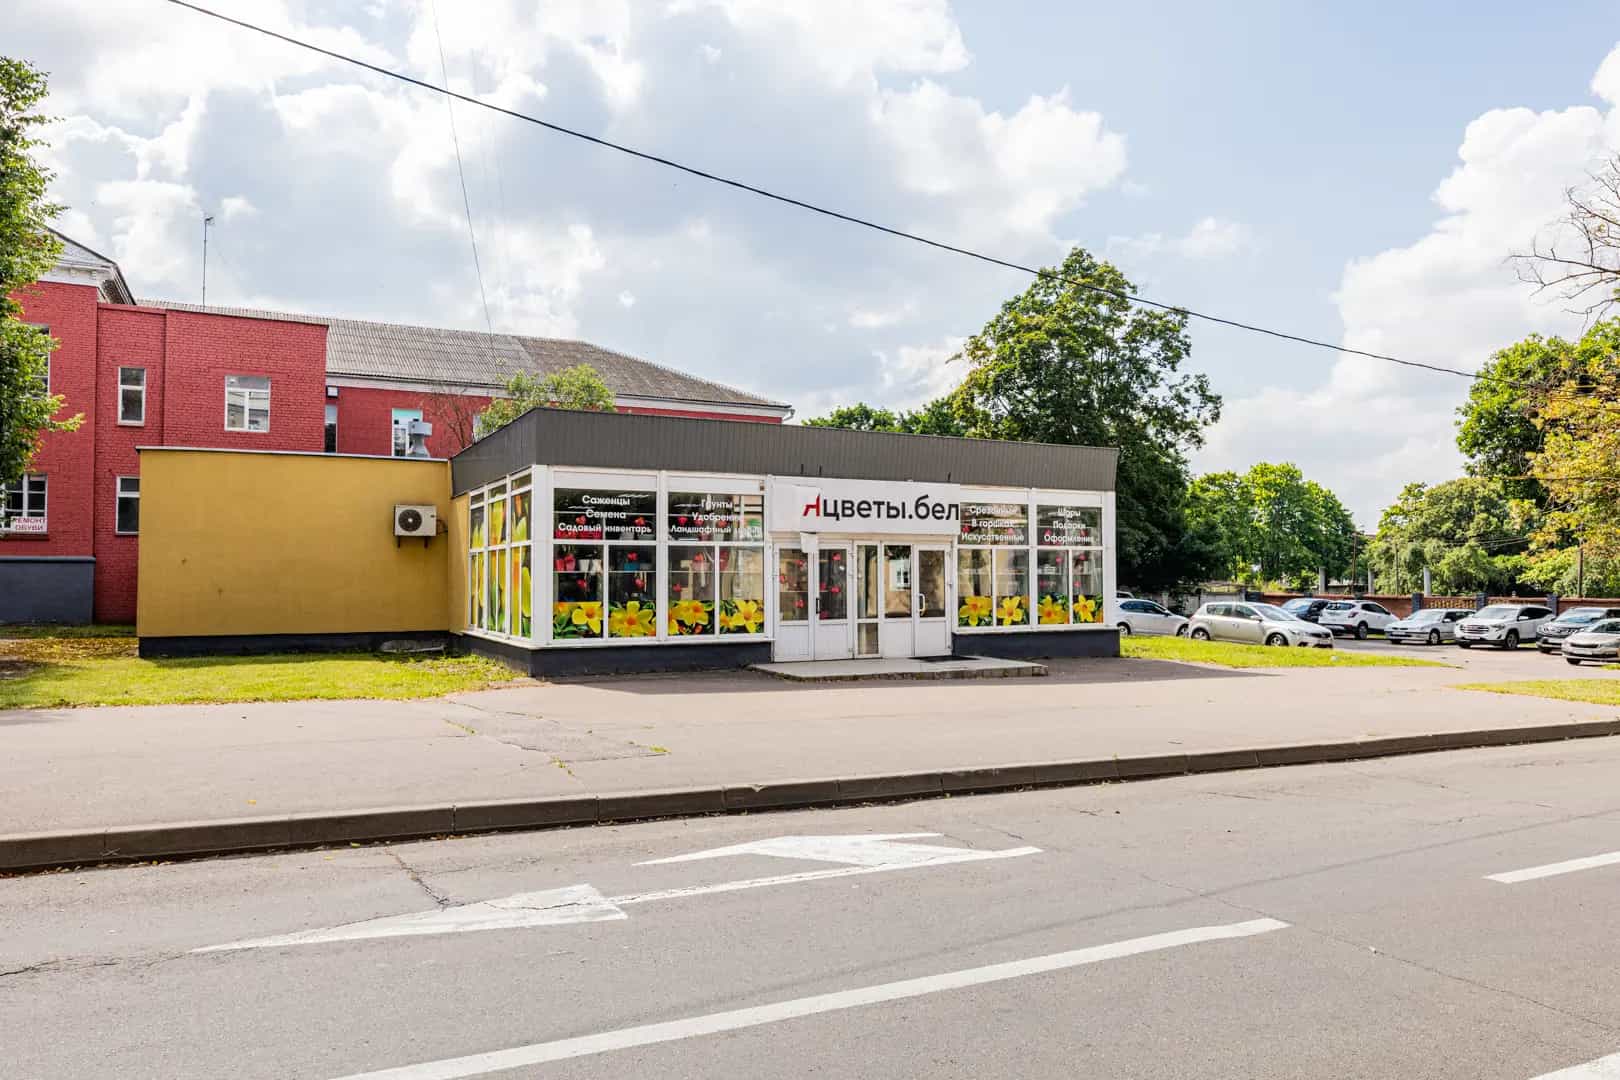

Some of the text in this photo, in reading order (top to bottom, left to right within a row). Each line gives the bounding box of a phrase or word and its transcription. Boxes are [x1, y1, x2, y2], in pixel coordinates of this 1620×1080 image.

[582, 495, 631, 506] Саженцы
[701, 499, 733, 510] Грунты
[585, 509, 627, 519] Семена
[1057, 507, 1081, 518] Шары
[558, 523, 652, 535] Садовый инвентарь
[671, 525, 732, 535] Ландшафтный
